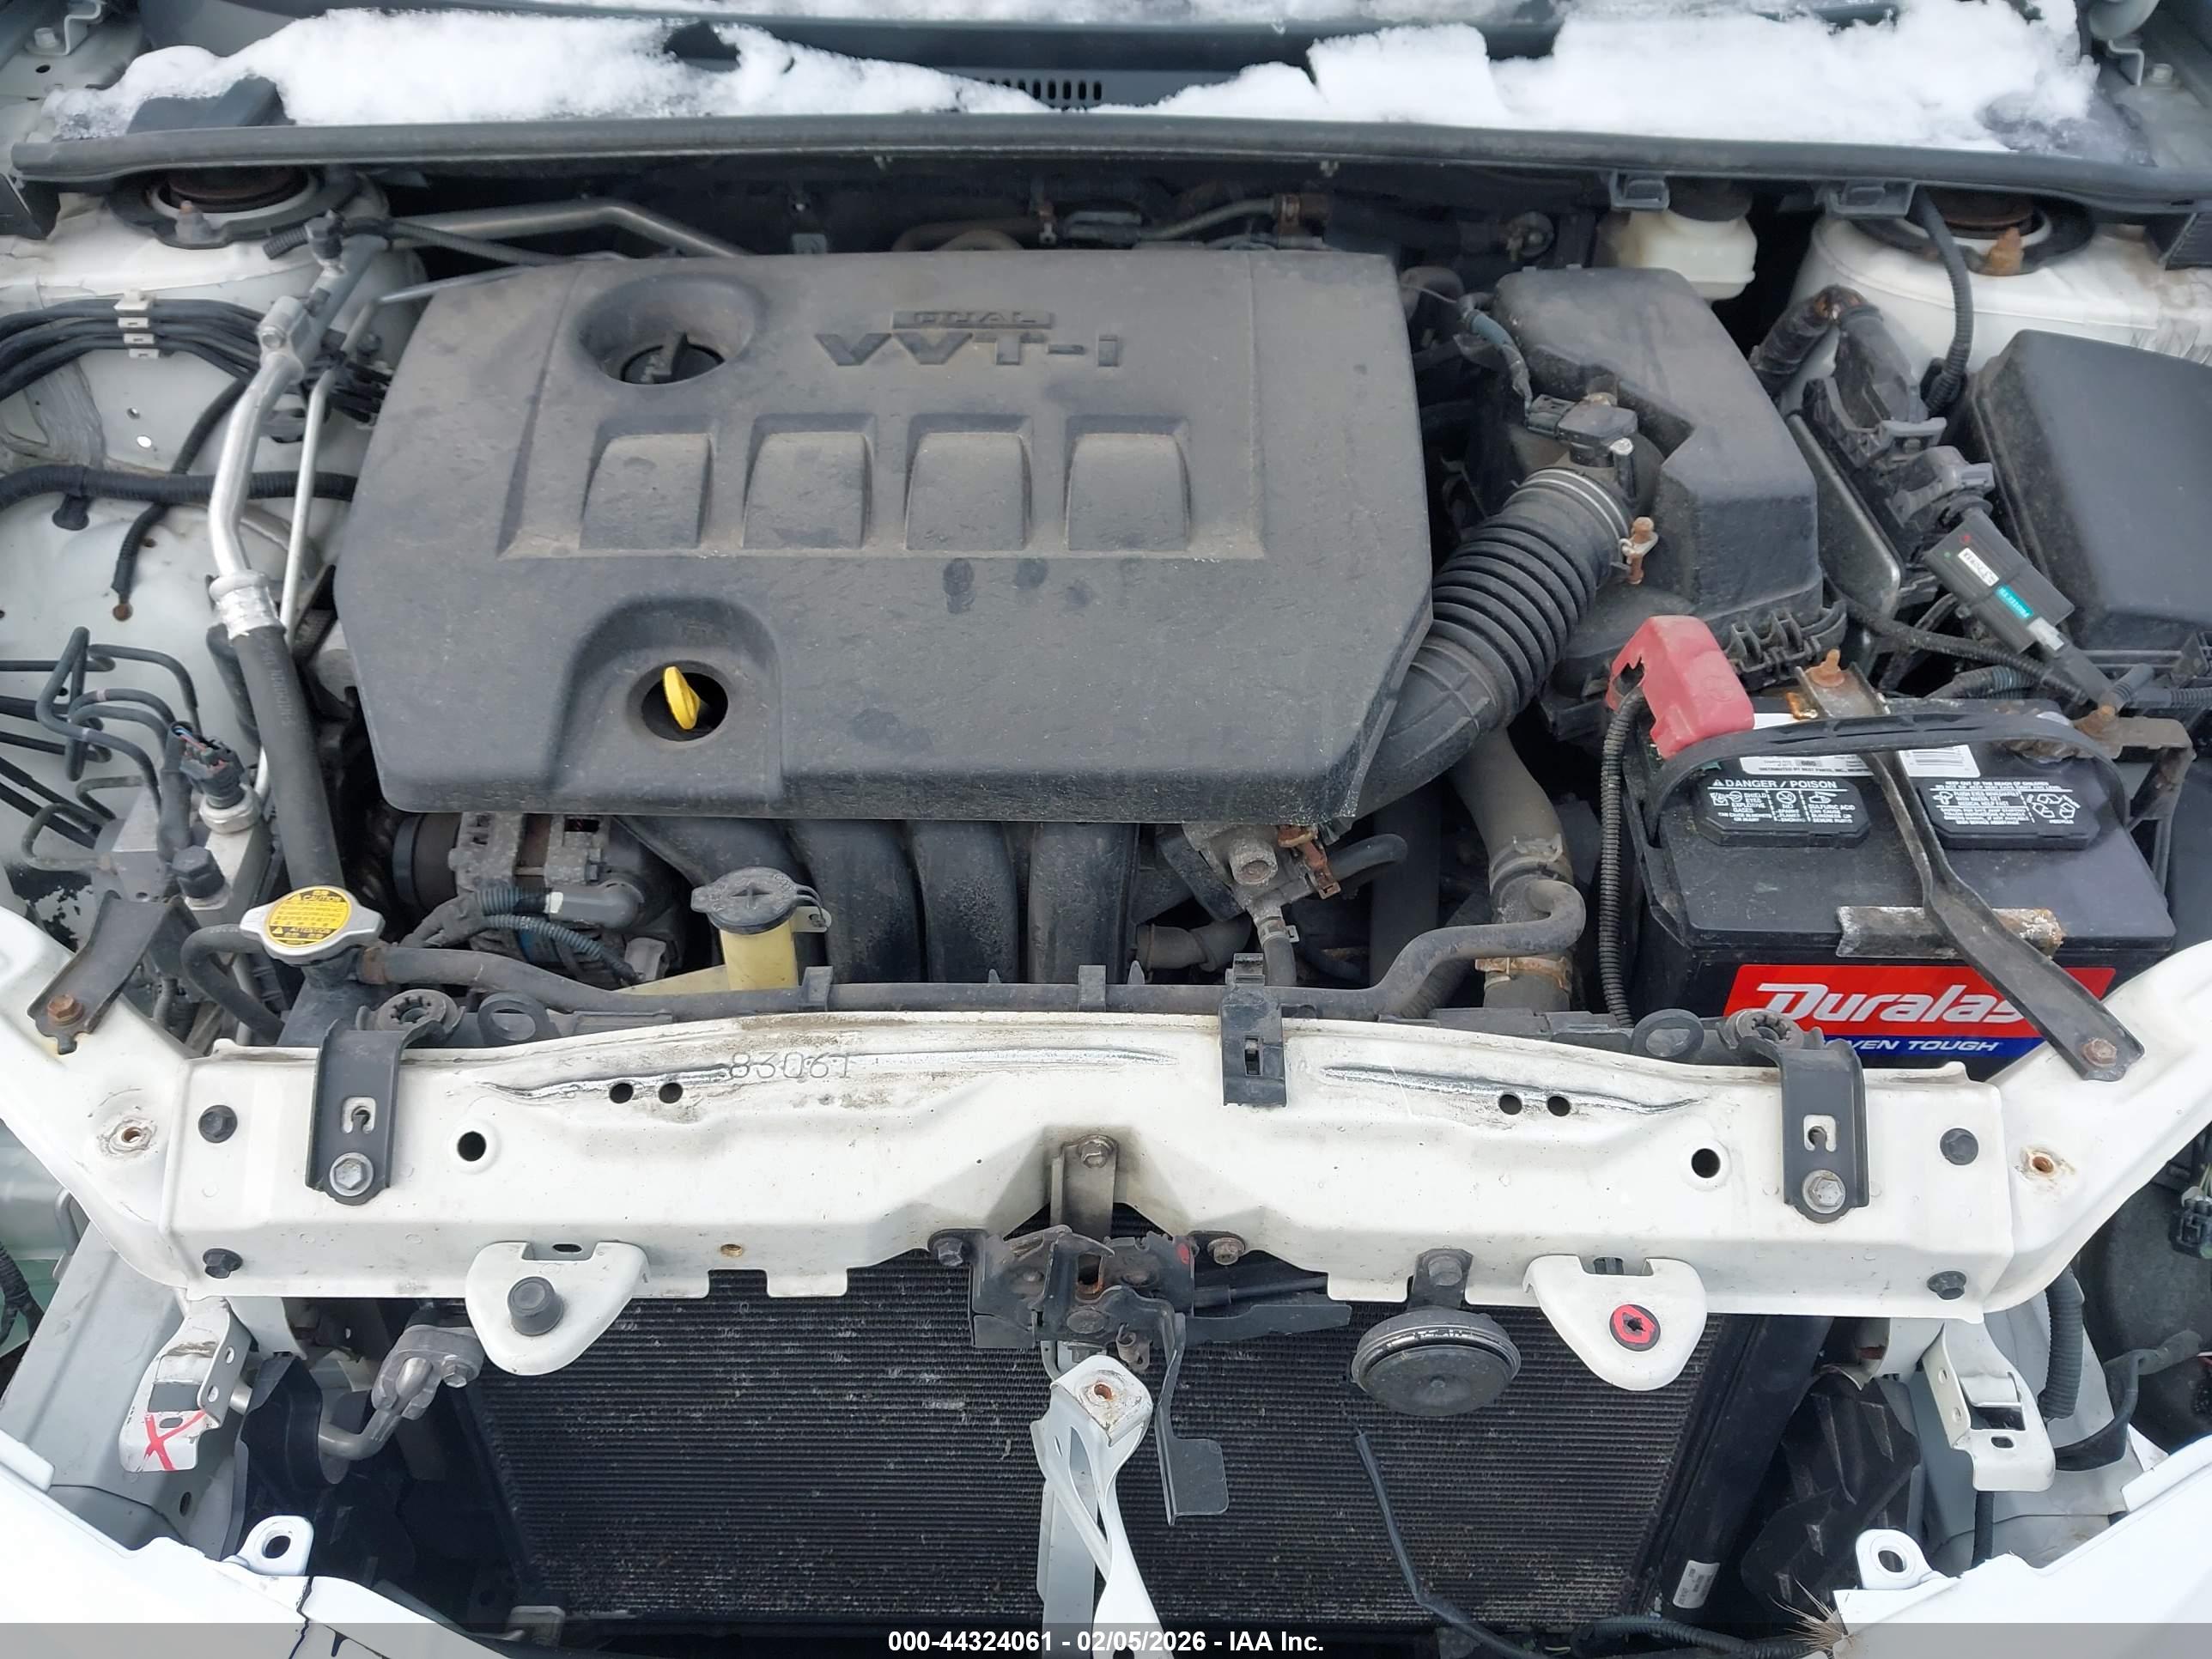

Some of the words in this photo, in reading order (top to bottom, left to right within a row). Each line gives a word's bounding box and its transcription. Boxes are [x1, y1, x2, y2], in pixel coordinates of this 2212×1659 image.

[1725, 780, 1777, 788] DANGER
[1757, 984, 2025, 1023] Duralas
[1848, 1040, 1900, 1050] VEN
[1908, 1040, 1997, 1052] TOUGH
[730, 1051, 851, 1079] 83061
